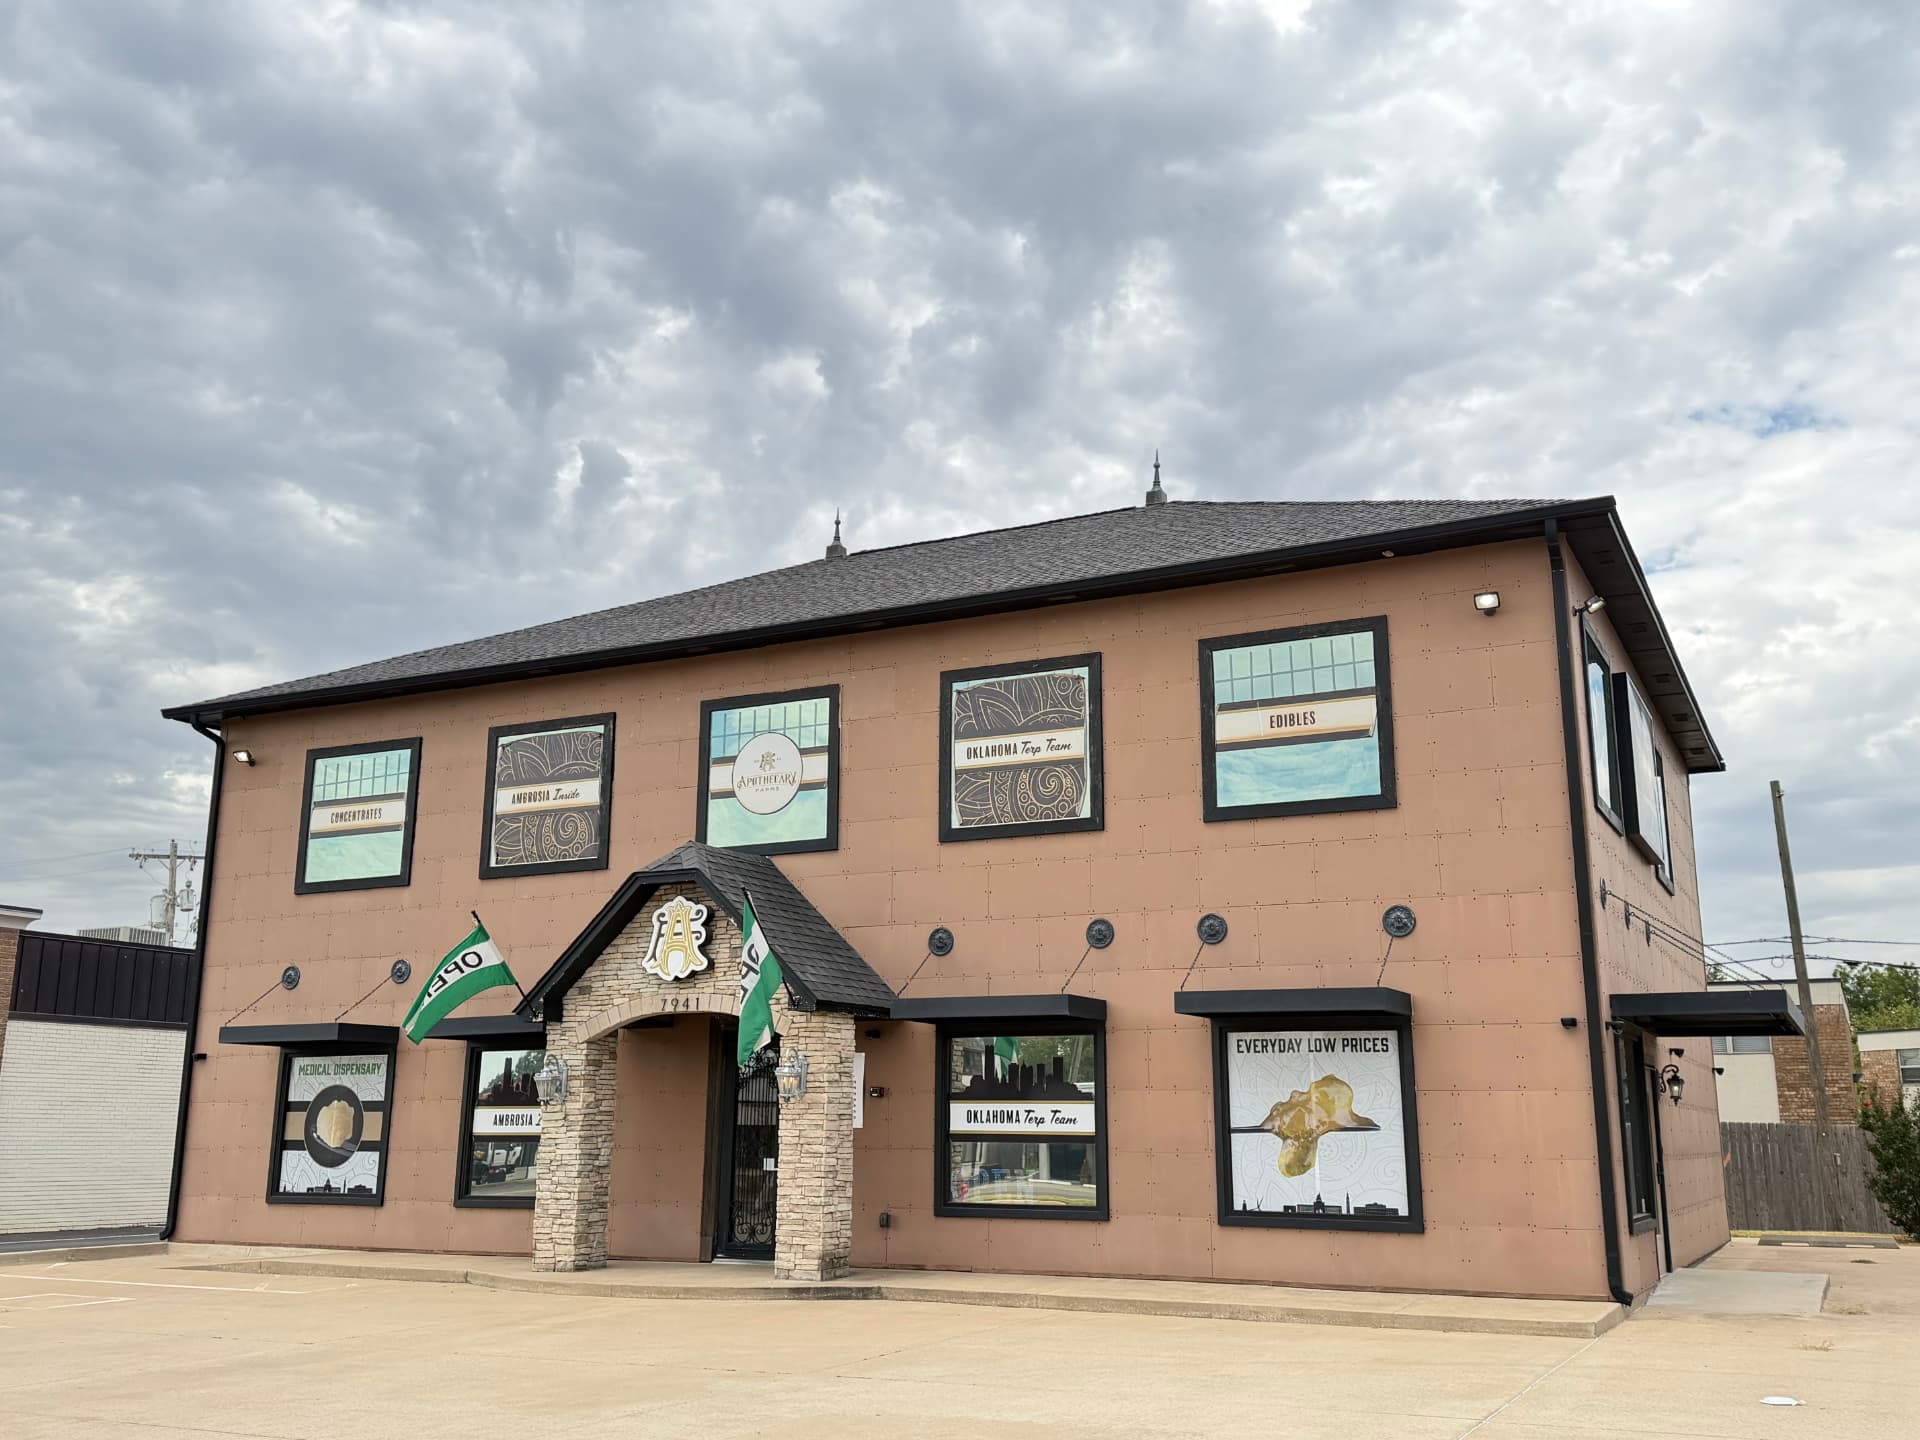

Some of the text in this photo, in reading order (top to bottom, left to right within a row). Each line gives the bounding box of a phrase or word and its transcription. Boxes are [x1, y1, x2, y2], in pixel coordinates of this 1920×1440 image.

[1269, 710, 1317, 729] EDIBLES
[966, 738, 1073, 759] OKLAHOMA Terp Team
[511, 787, 582, 805] AMBROSIA Inside
[330, 807, 383, 824] CONCENTRATES
[661, 997, 700, 1011] 7941
[1236, 1037, 1389, 1054] EVERYDAY LOW PRICES
[299, 1062, 382, 1076] MEDICAL DISPENSARY
[493, 1113, 533, 1127] AMBROSIA
[966, 1109, 1079, 1128] OKLAHOMA Terp Team
